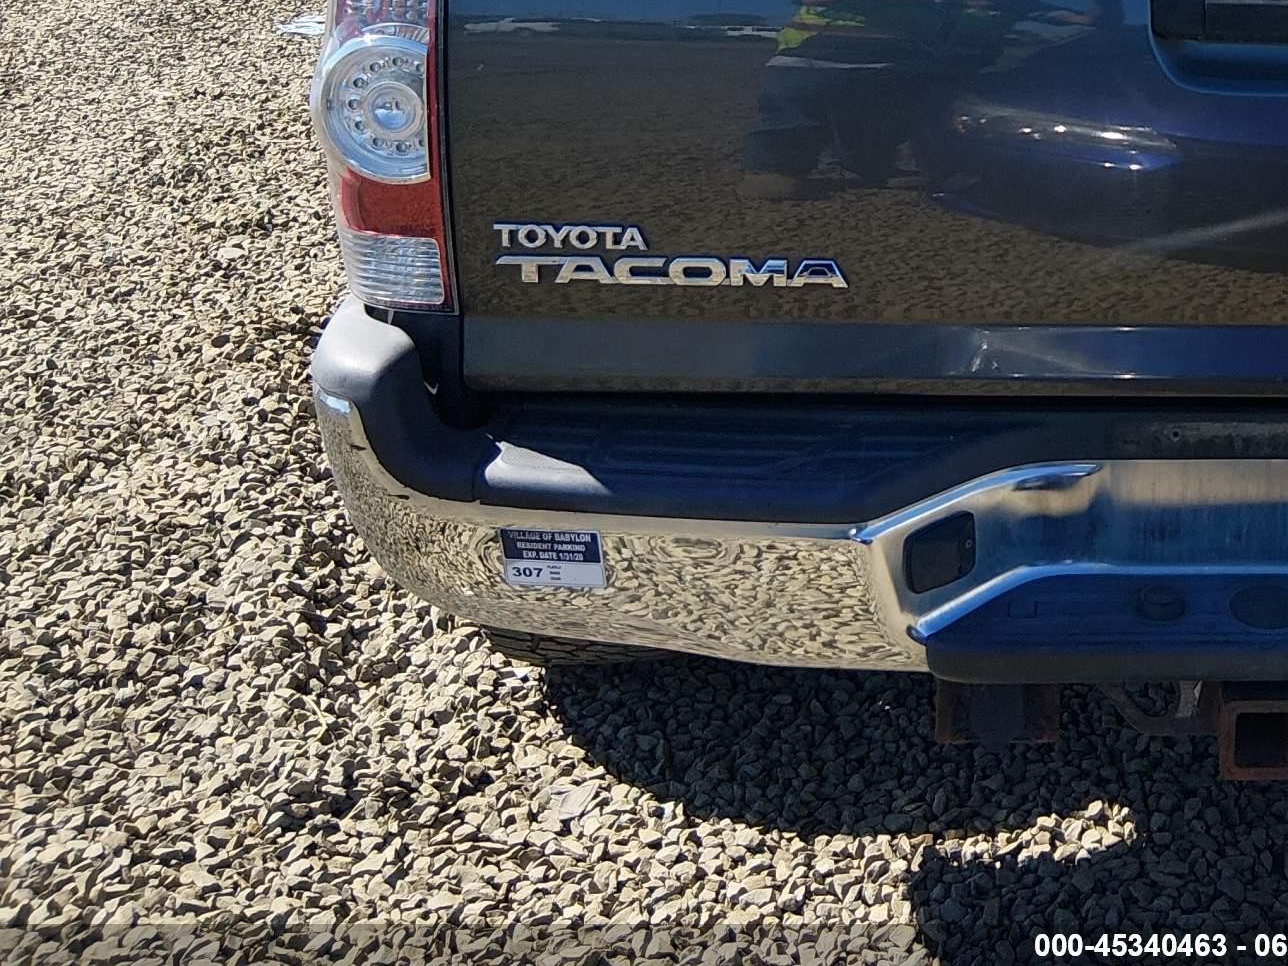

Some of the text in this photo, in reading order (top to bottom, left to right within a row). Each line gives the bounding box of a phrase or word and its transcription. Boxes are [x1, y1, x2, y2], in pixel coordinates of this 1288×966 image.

[493, 223, 648, 251] TOYOTA
[495, 255, 849, 289] TACOMA
[542, 532, 553, 540] OF
[554, 532, 592, 543] BABYLON
[516, 541, 552, 551] RESIDENT
[522, 550, 539, 559] EXP.
[540, 551, 558, 561] DATE
[511, 566, 544, 578] 307
